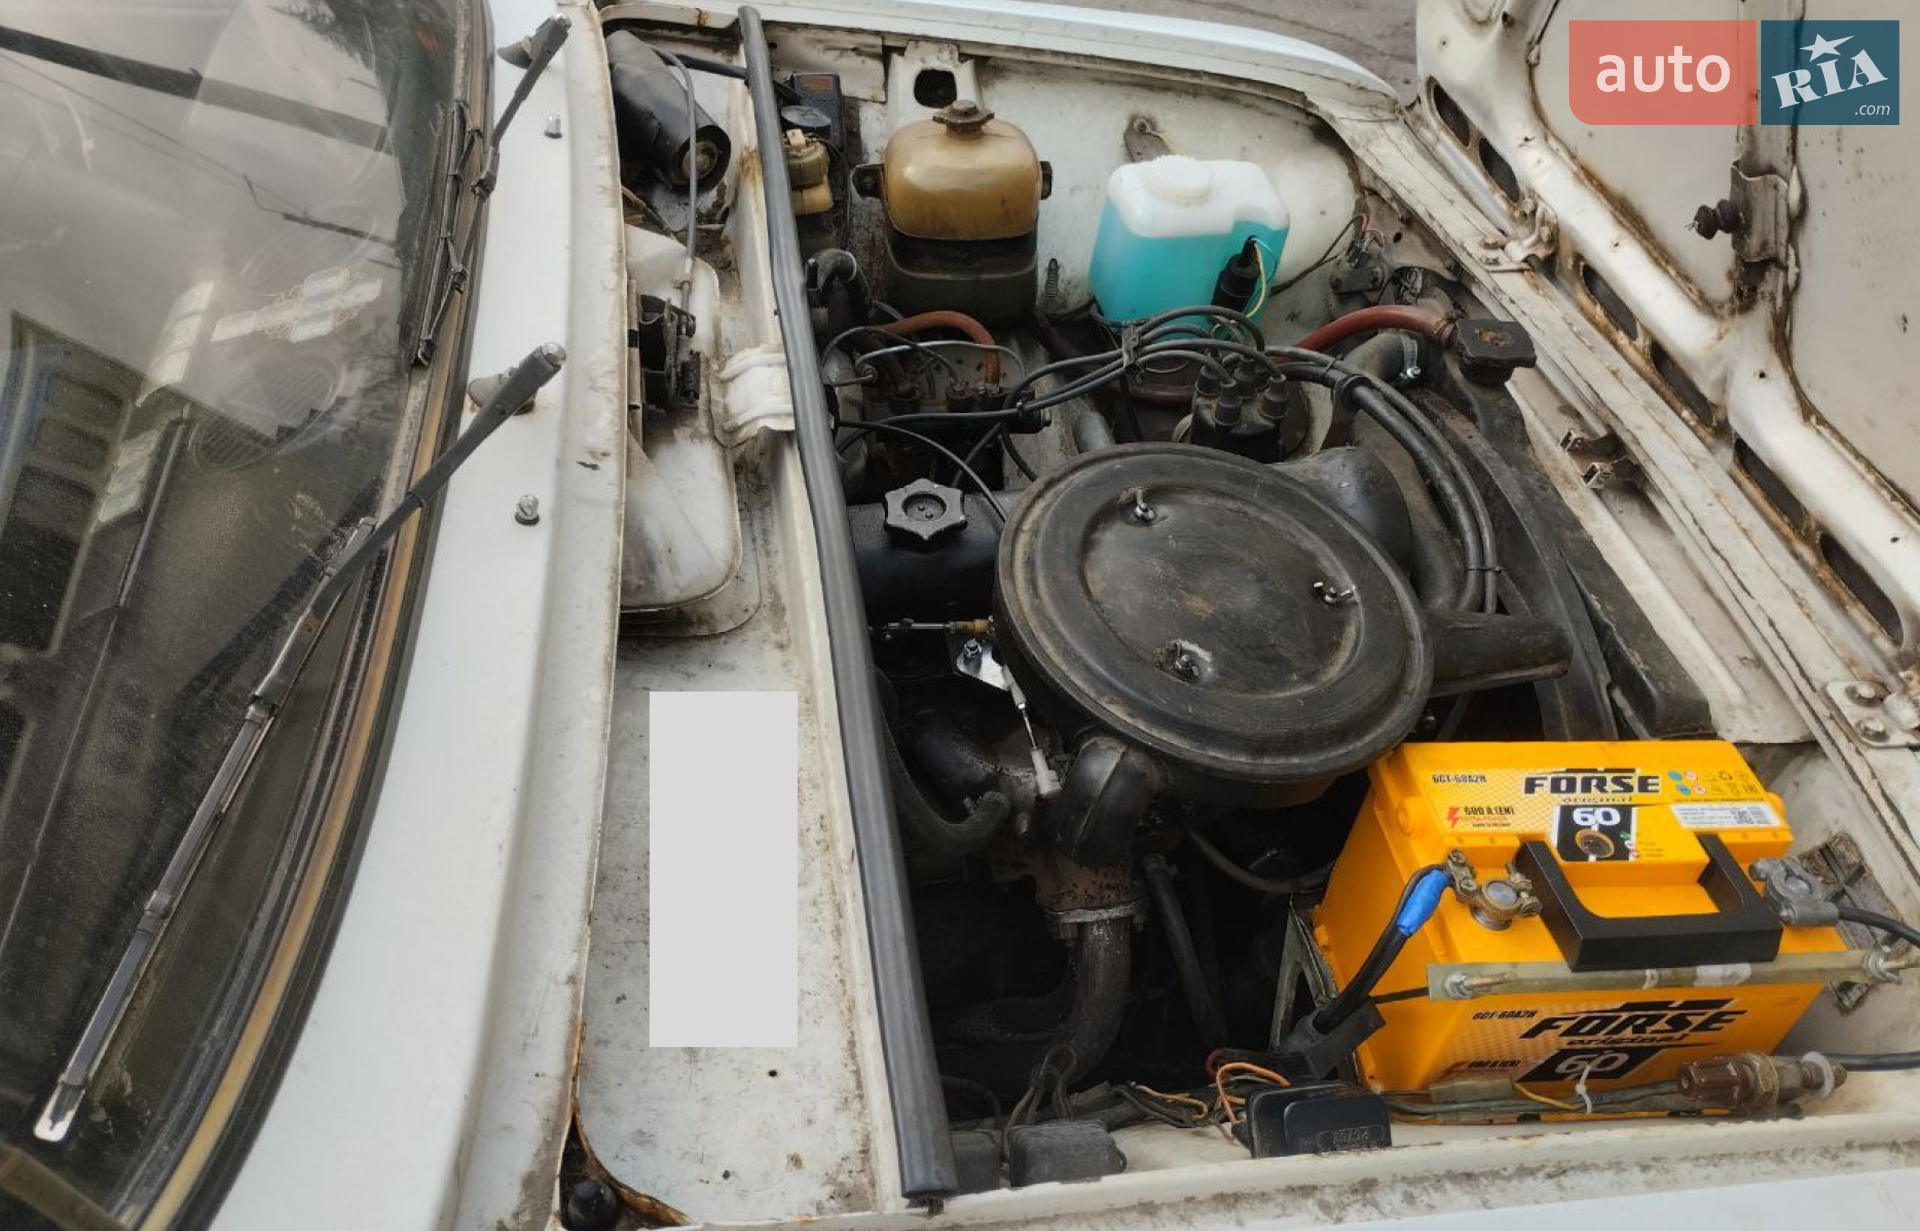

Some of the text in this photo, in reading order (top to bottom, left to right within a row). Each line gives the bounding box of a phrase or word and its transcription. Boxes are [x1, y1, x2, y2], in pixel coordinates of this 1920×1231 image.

[1524, 775, 1660, 794] FORSE
[1573, 807, 1621, 826] 60
[1519, 1010, 1748, 1039] FORSE
[1554, 1052, 1630, 1074] 60
